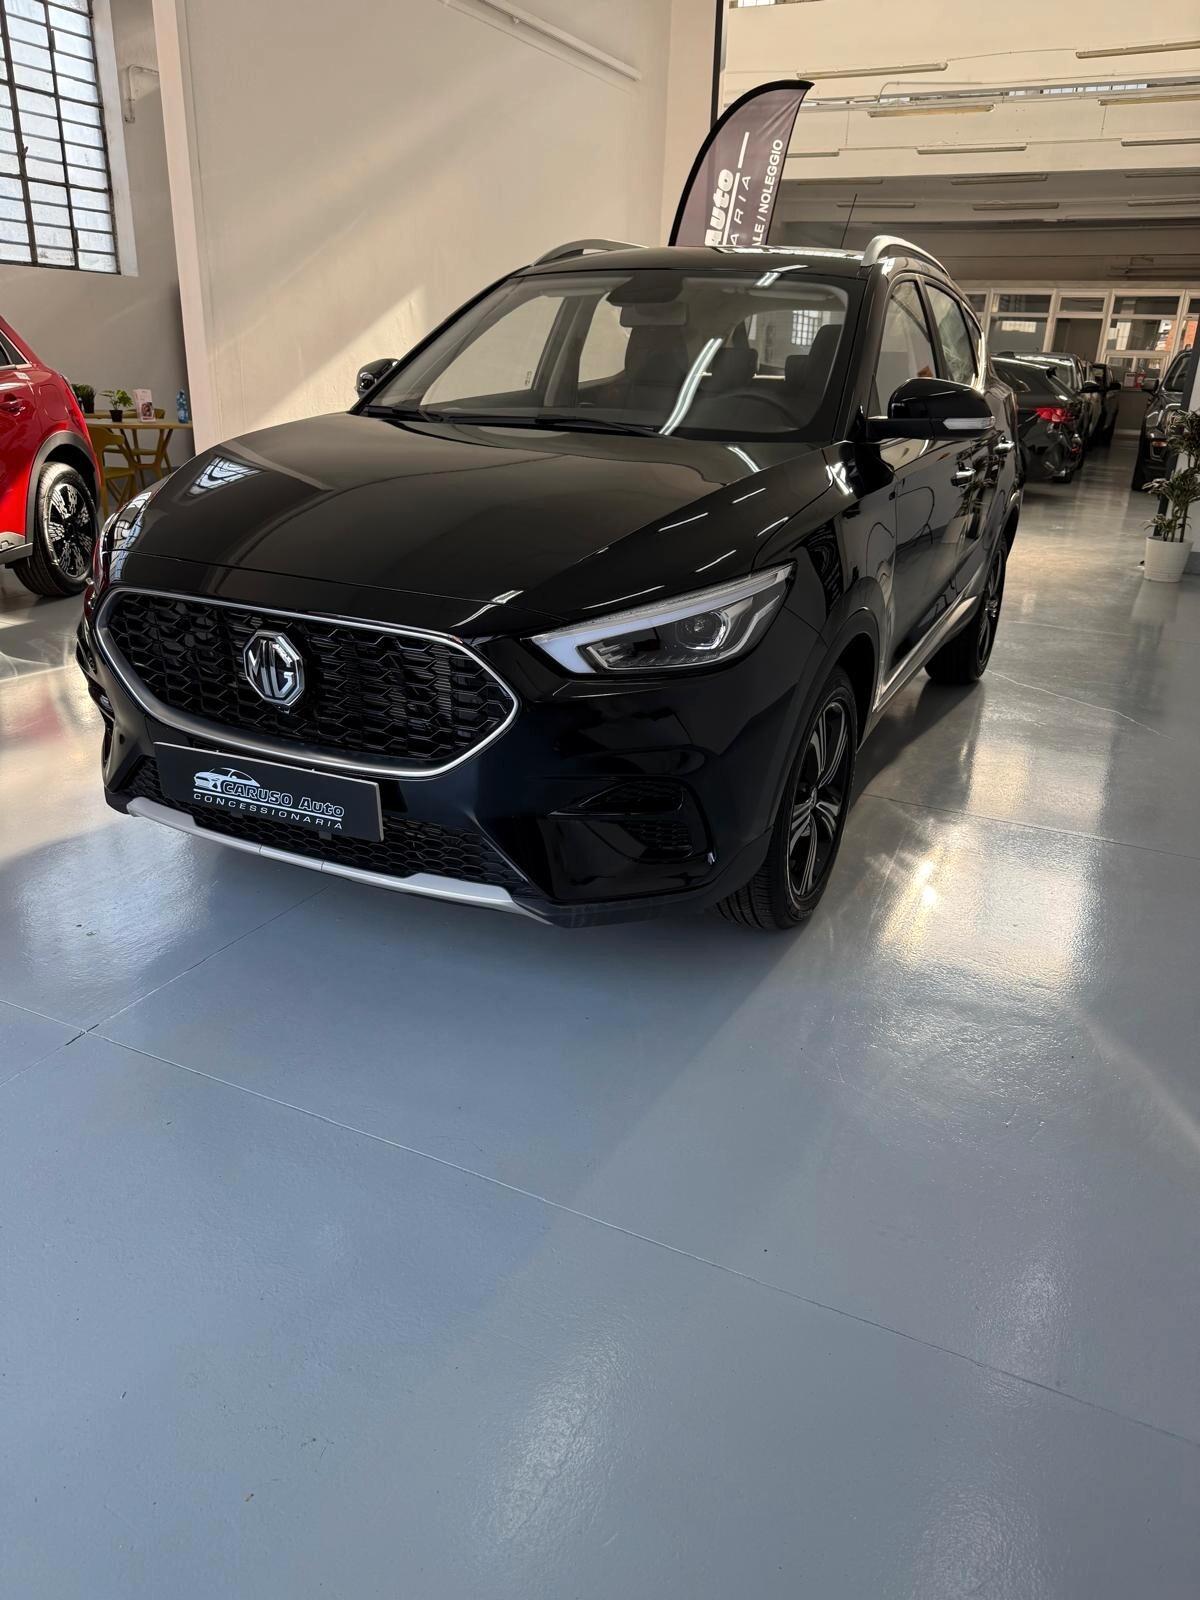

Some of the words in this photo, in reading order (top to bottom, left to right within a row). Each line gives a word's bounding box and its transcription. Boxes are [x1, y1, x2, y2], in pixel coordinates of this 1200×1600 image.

[758, 139, 784, 214] NOLEGGIO
[247, 638, 294, 698] MG
[193, 793, 343, 829] CONCESSIONARIA
[222, 781, 293, 807] CARUSO
[298, 796, 345, 817] Auto
